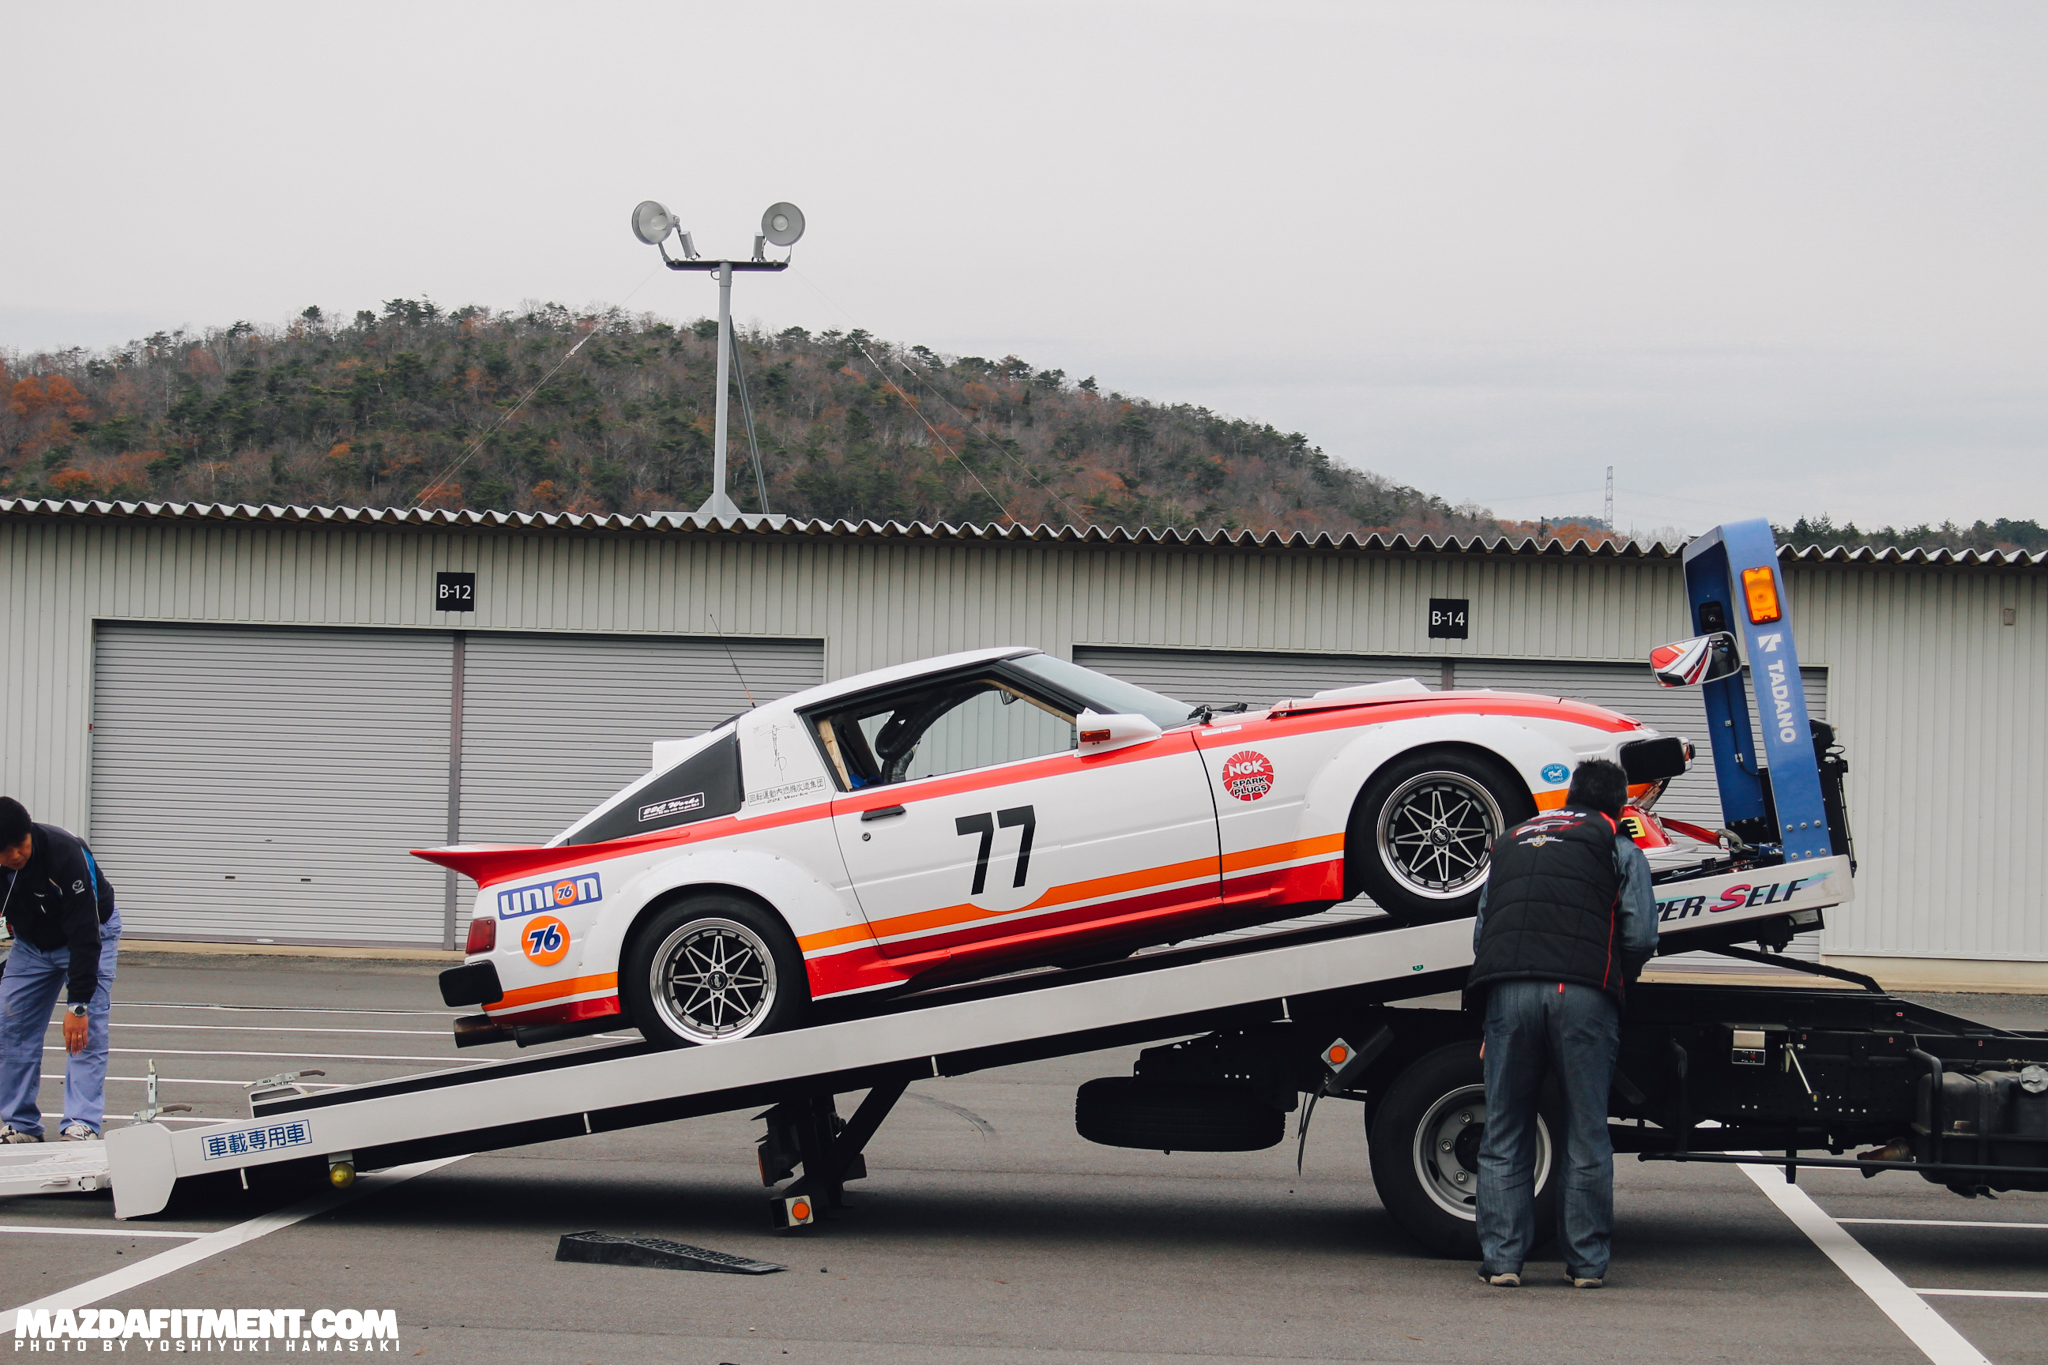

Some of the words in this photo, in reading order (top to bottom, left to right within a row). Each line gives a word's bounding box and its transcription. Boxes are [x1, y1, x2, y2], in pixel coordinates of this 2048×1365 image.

[440, 584, 471, 599] B-12
[1432, 610, 1465, 626] B-14
[1767, 659, 1797, 744] TADANO
[1228, 758, 1265, 777] NGK
[1232, 775, 1267, 788] SPARK
[1234, 784, 1268, 796] PLUGS
[955, 804, 1037, 896] 77
[526, 922, 563, 957] 76
[207, 1123, 307, 1157] 車載専用車
